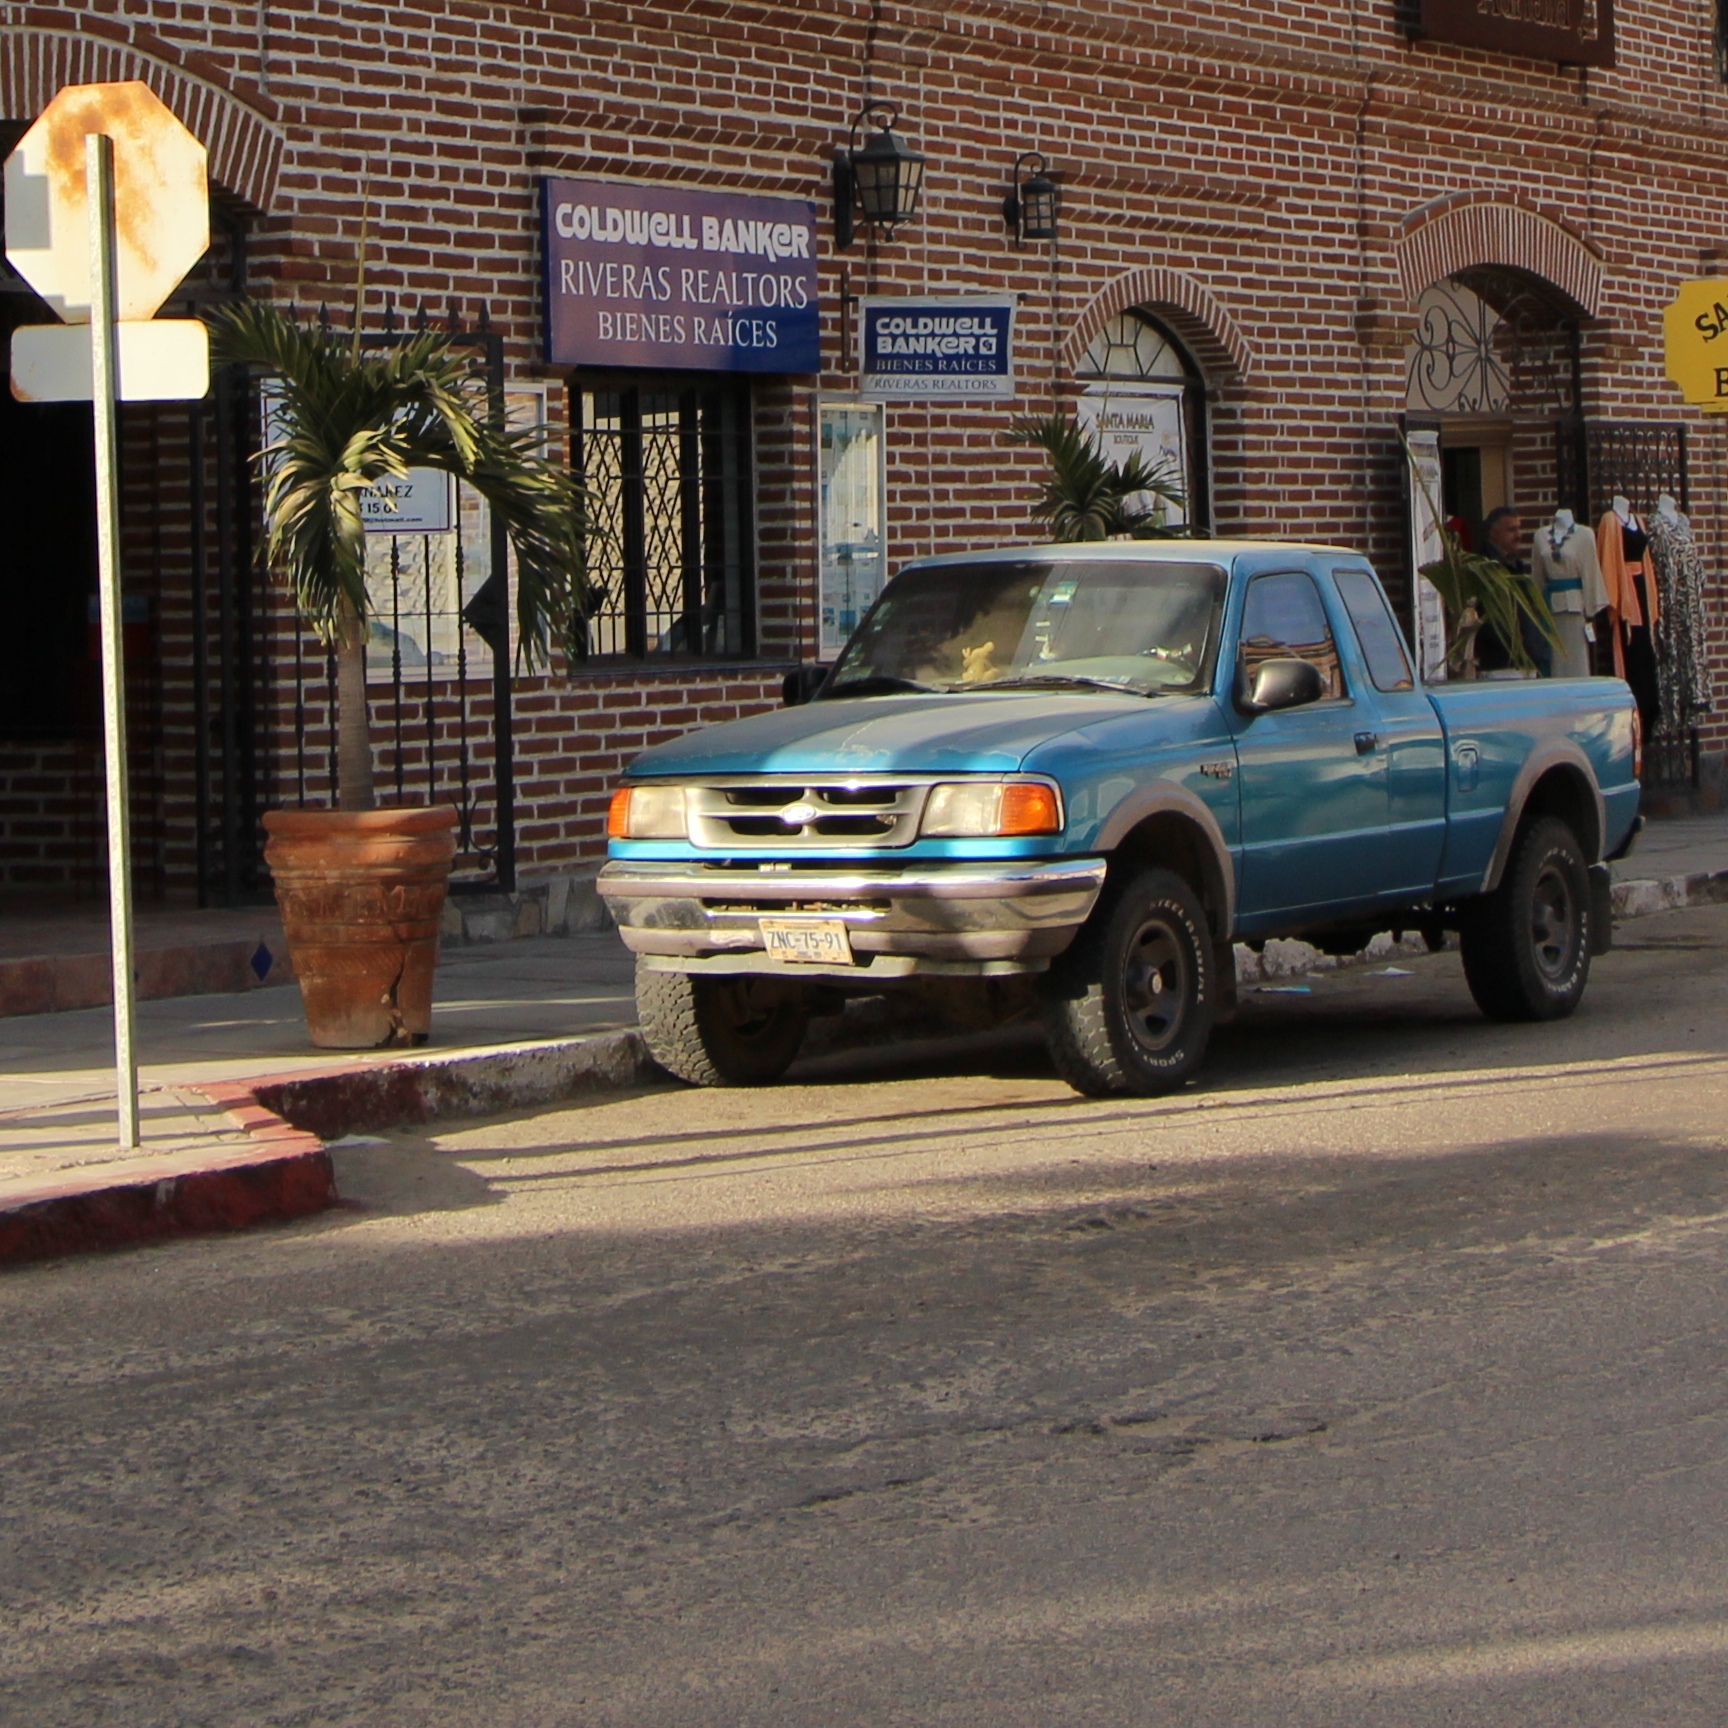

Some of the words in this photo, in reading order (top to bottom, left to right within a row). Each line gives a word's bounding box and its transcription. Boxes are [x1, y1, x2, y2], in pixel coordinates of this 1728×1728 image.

[555, 202, 699, 250] COLDWELL
[702, 216, 810, 262] BANKER
[560, 259, 671, 302] RIVERAS
[681, 268, 808, 309] REALTORS
[598, 310, 687, 344] BIENES
[693, 310, 778, 348] RAÍCES
[875, 317, 998, 335] COLDWELL
[877, 336, 976, 357] BANKER
[876, 359, 934, 371] BIENES
[938, 357, 996, 371] RAÍCES
[874, 378, 928, 390] RIVERAS
[932, 378, 997, 390] REALTORS
[1095, 412, 1125, 429] SANTA
